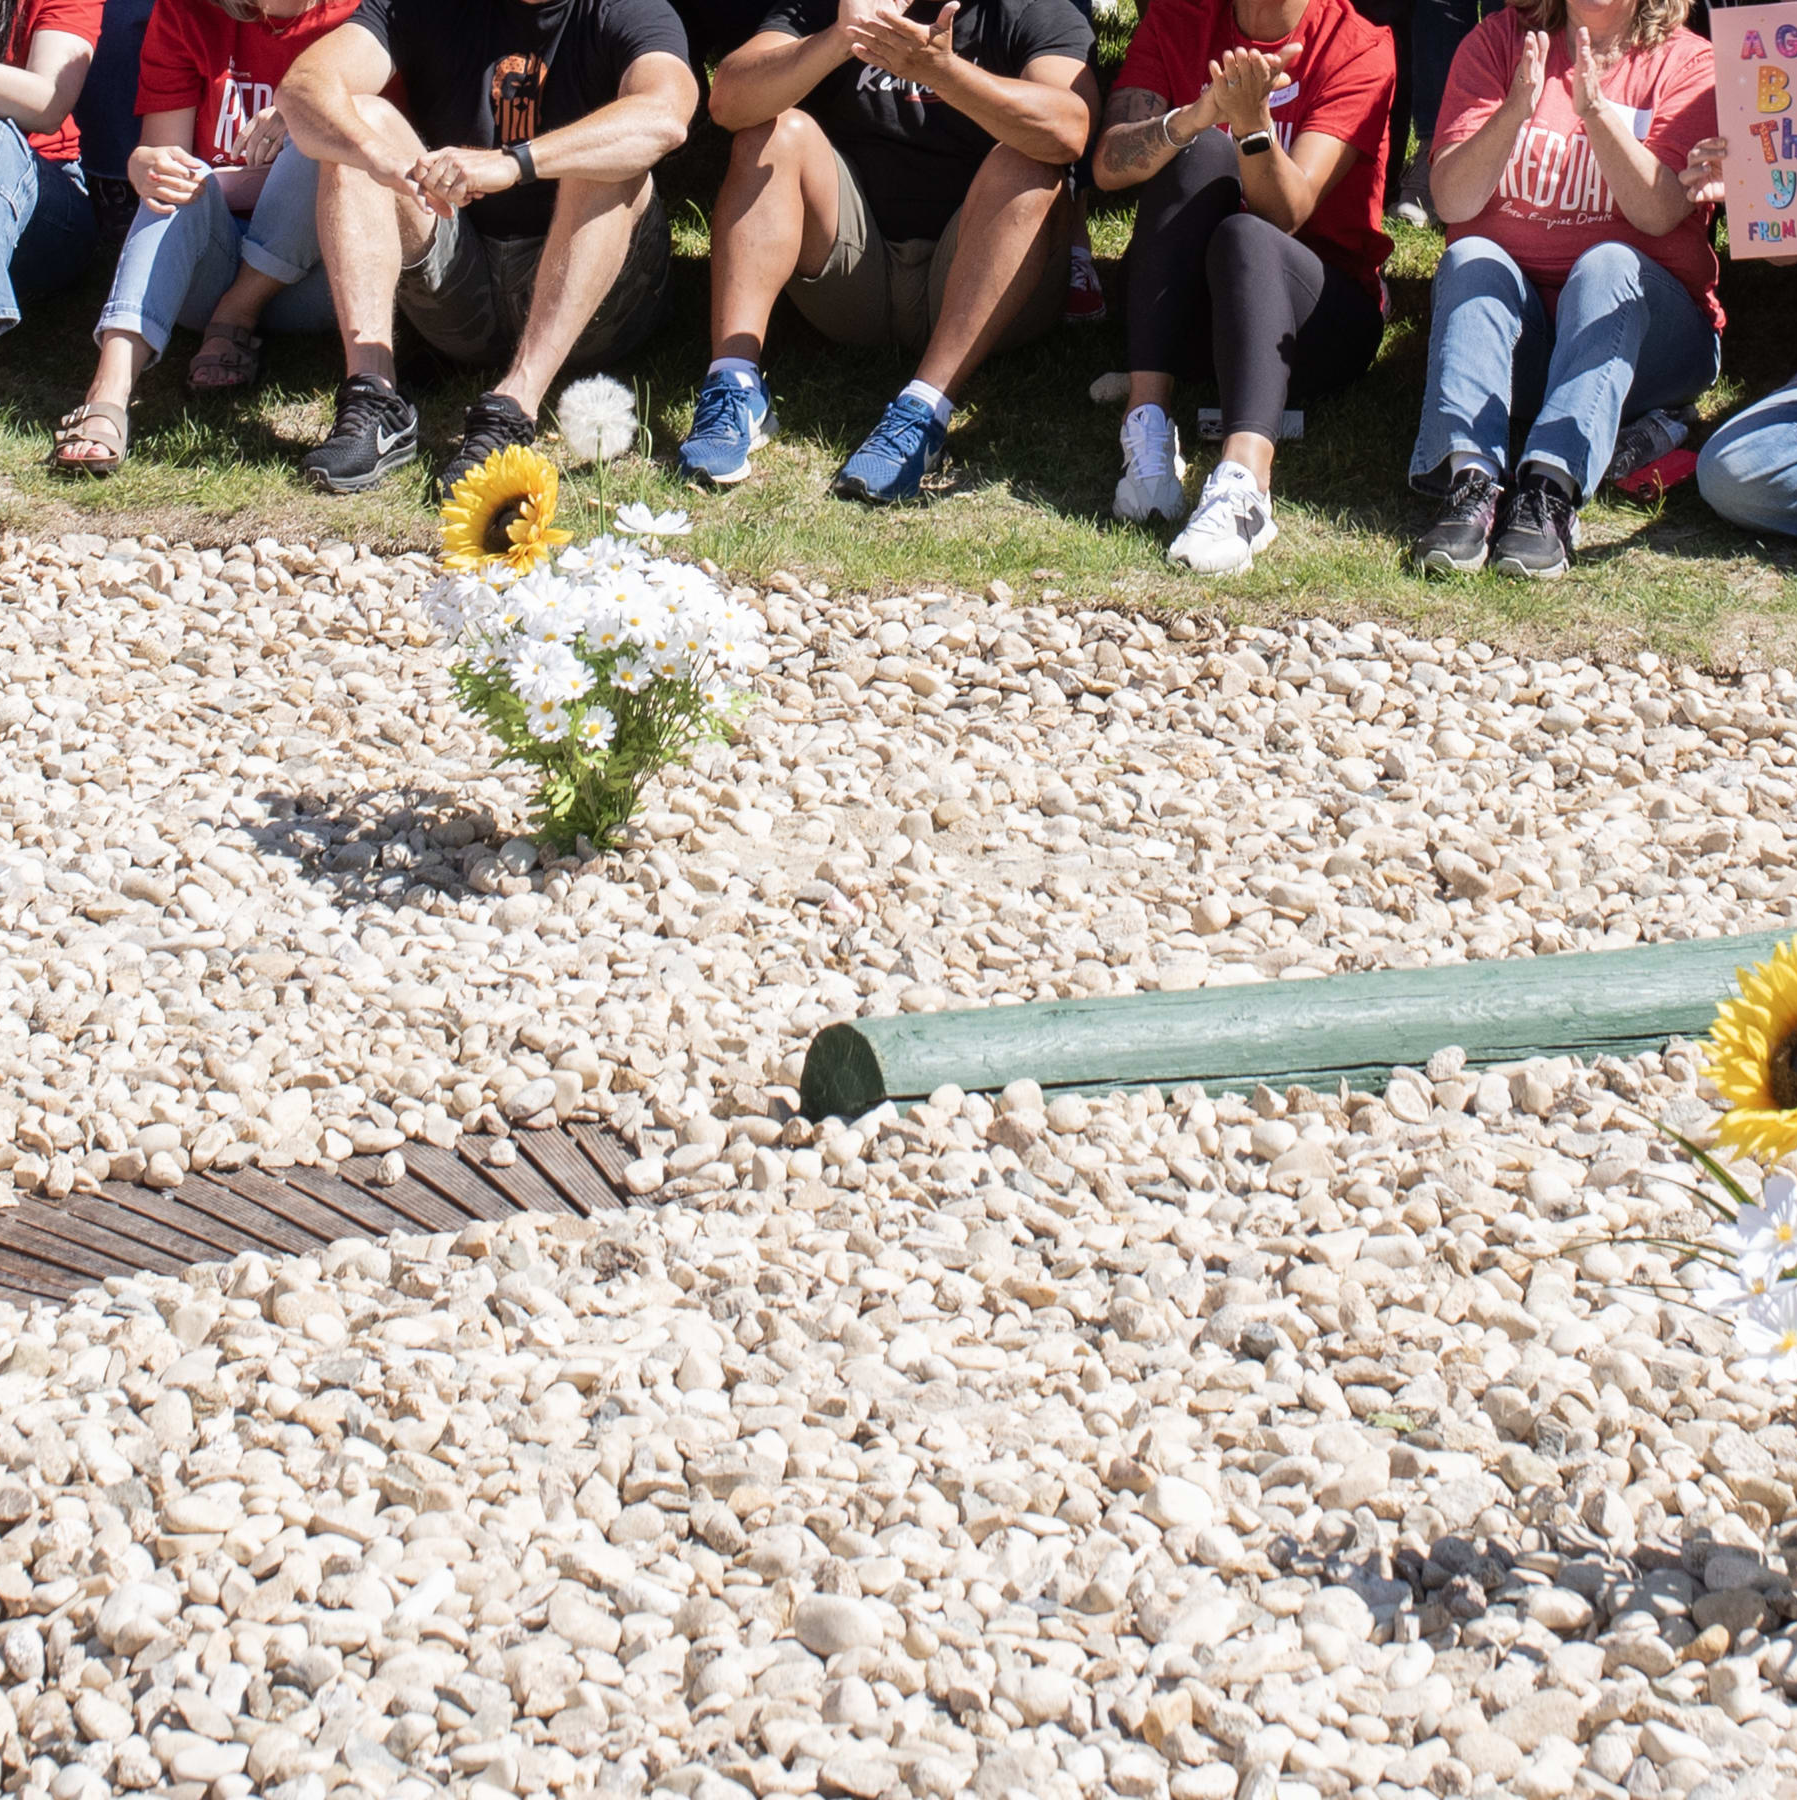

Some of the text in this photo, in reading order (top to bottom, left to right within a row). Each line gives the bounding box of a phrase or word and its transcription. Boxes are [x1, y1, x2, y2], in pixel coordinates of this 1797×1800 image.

[1740, 29, 1767, 60] A
[1499, 125, 1566, 208] RED
[1748, 220, 1797, 242] FROM
